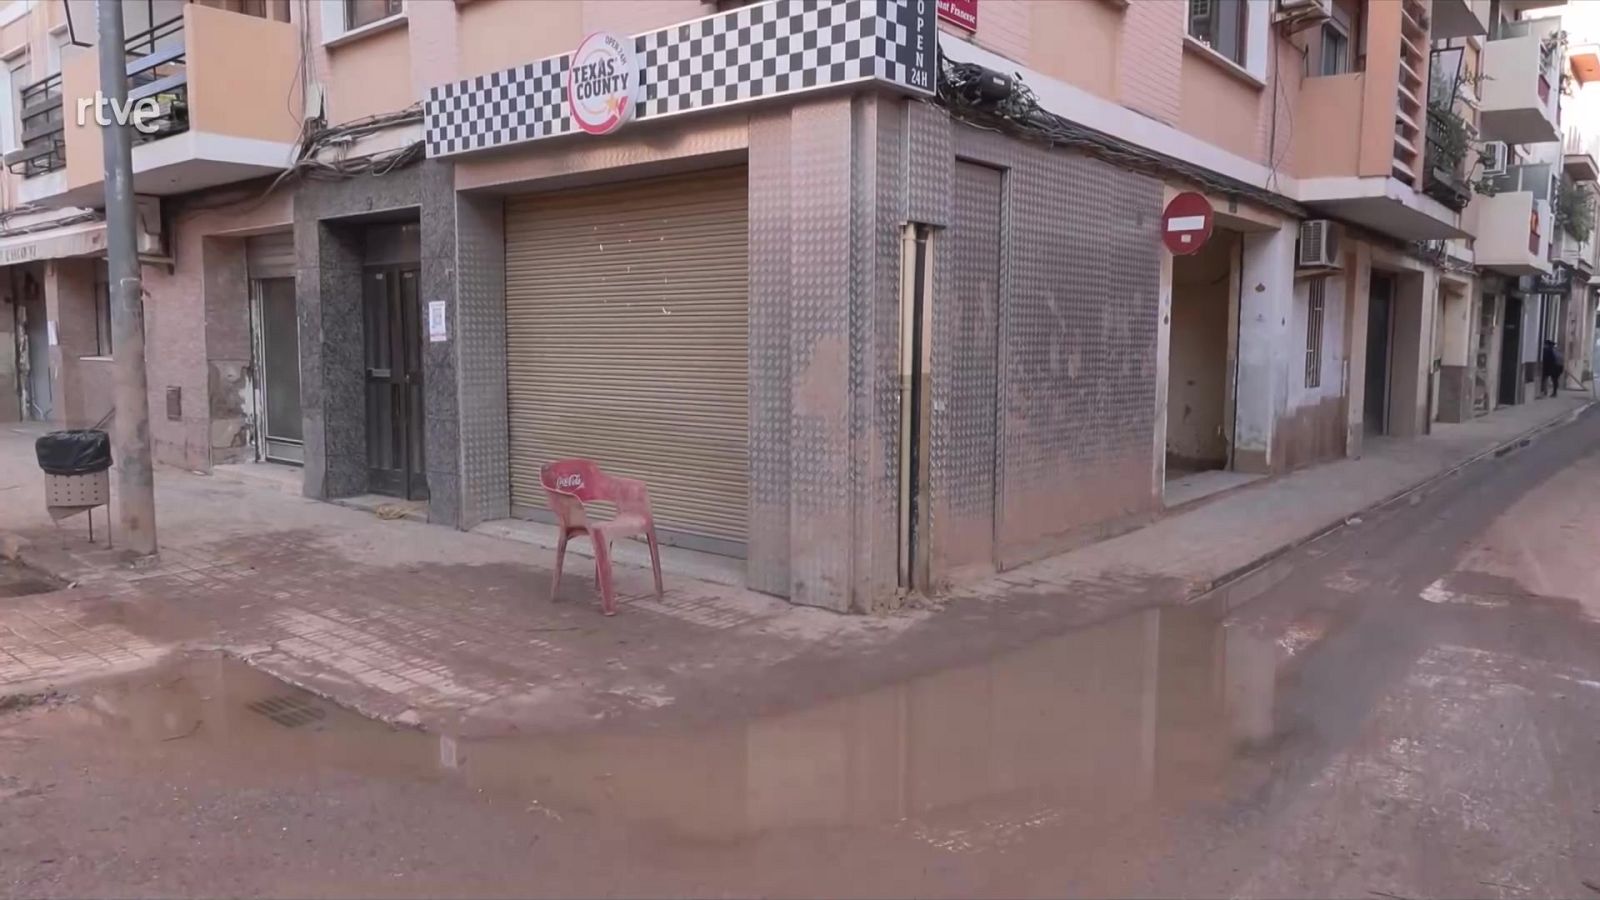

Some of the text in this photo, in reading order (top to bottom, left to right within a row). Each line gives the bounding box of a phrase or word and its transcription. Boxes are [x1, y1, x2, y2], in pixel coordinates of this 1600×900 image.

[605, 35, 620, 51] OPEN
[916, 0, 925, 68] OPEN
[576, 72, 629, 100] COUNTY
[911, 68, 928, 88] 24H
